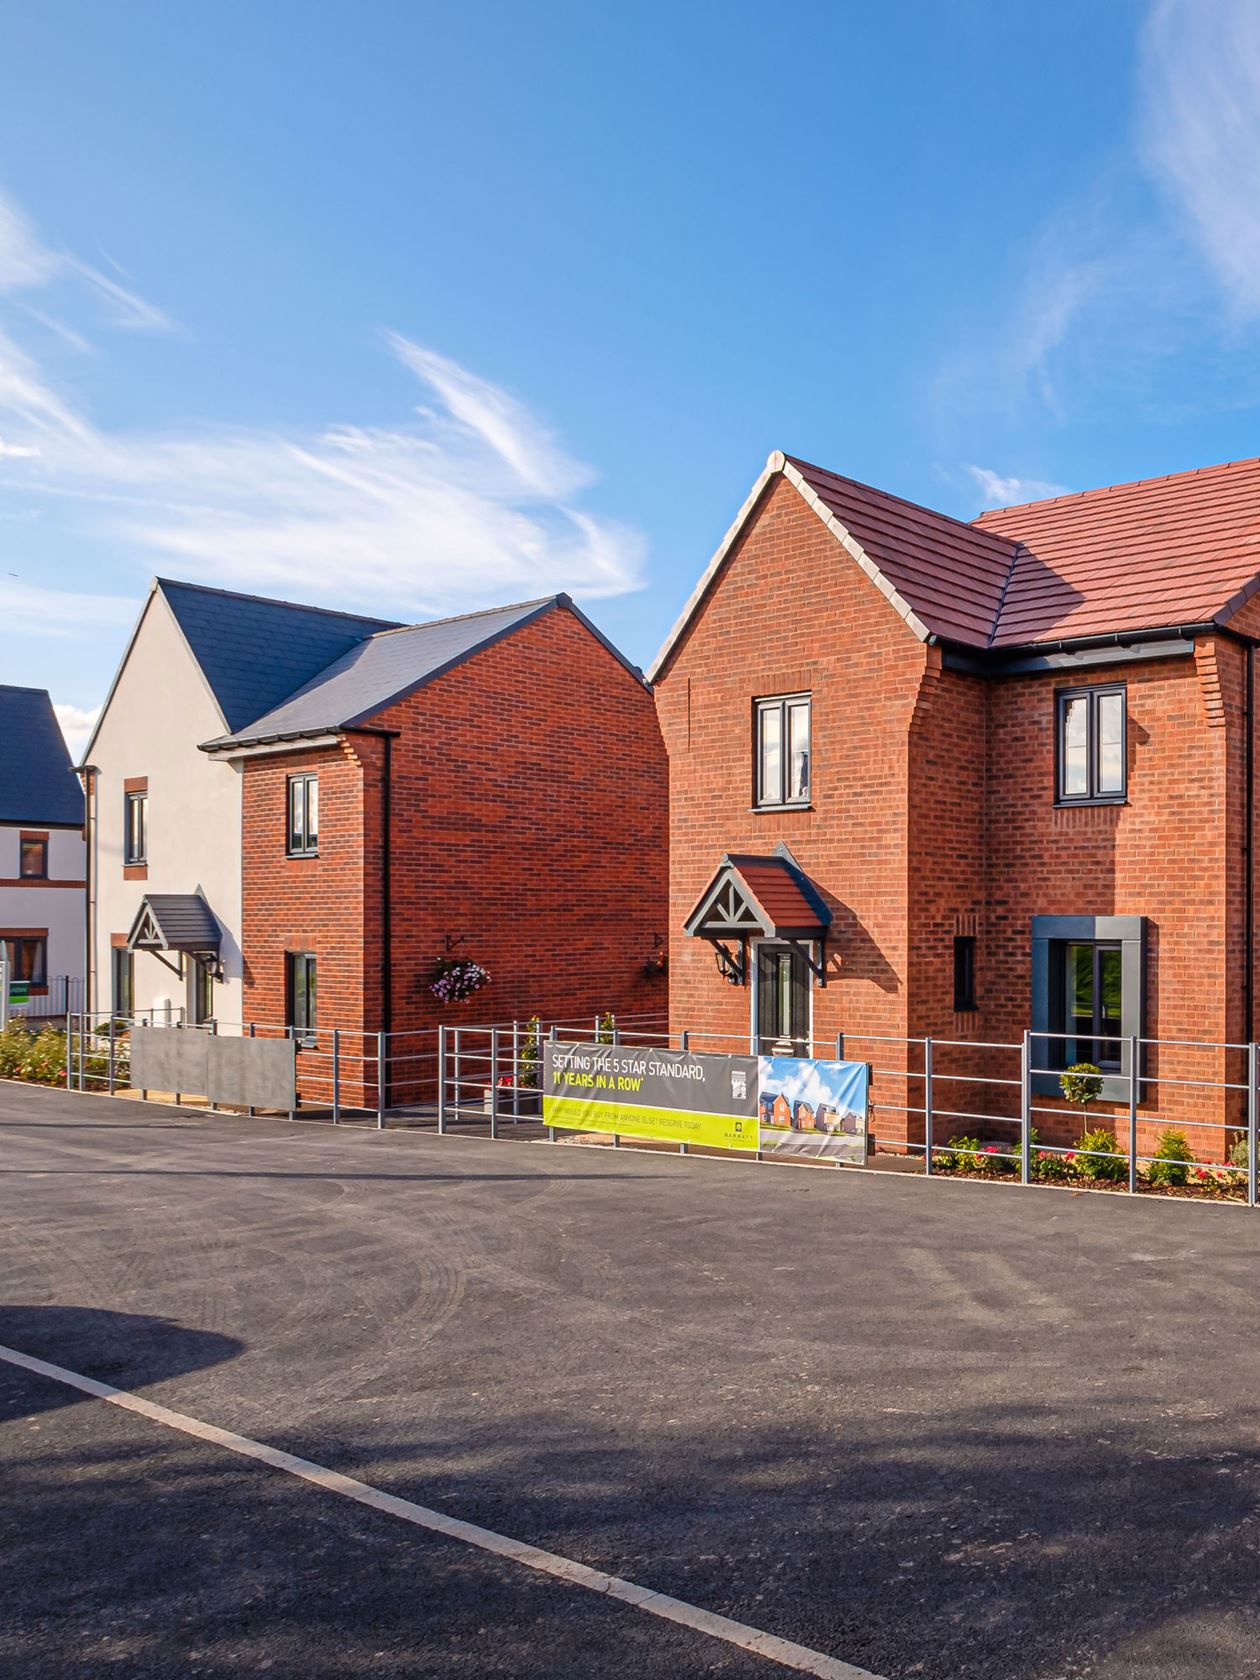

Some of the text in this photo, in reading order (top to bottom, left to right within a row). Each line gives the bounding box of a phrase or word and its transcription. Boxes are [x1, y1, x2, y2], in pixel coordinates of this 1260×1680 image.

[552, 1054, 706, 1083] SETTING THE 5 STAR STANDARD,
[553, 1071, 560, 1084] 11
[563, 1071, 594, 1088] YEARS
[596, 1074, 606, 1089] IN
[608, 1076, 615, 1090] A
[605, 1112, 619, 1120] FROM
